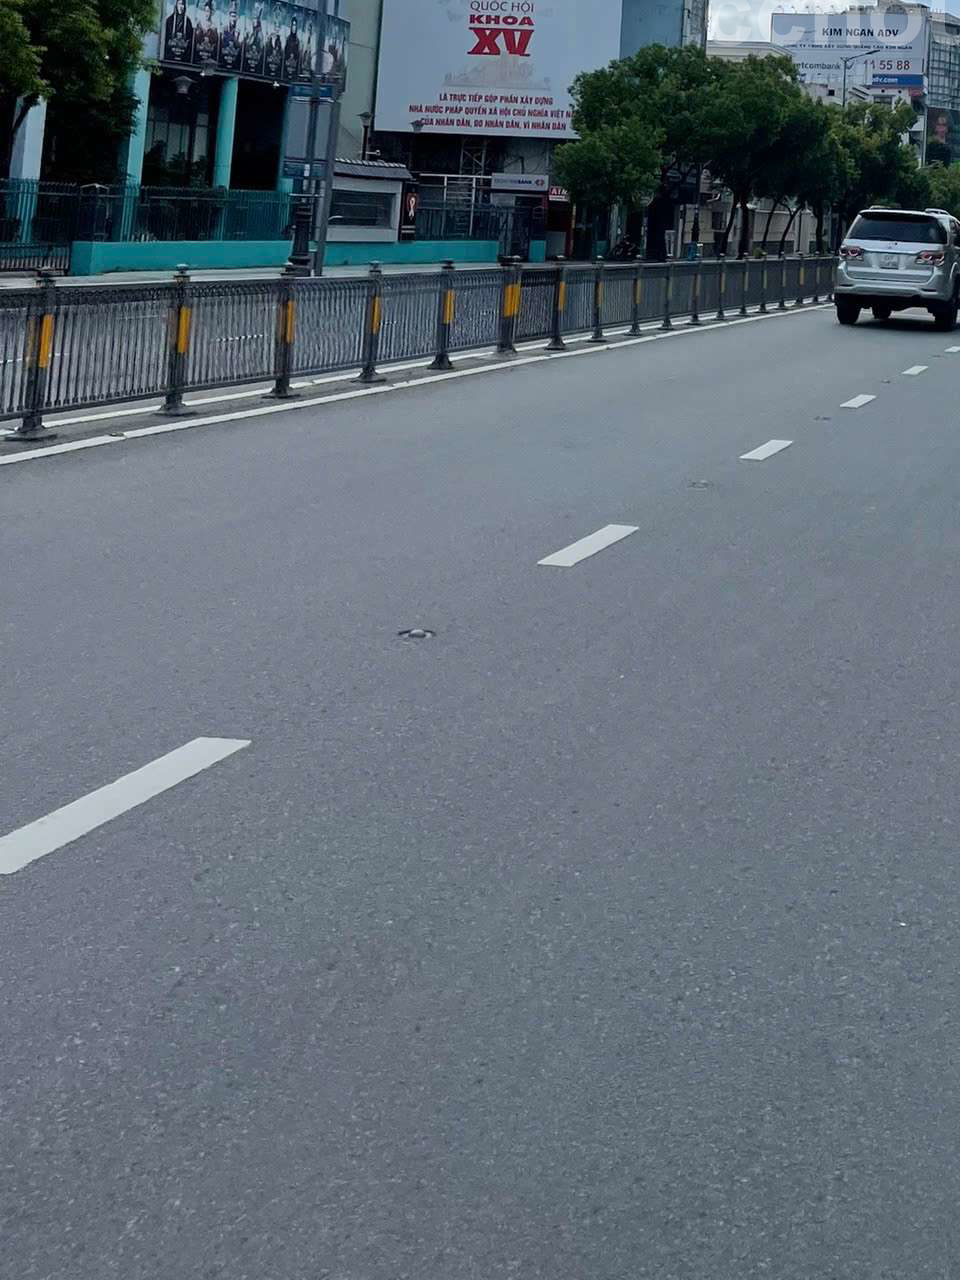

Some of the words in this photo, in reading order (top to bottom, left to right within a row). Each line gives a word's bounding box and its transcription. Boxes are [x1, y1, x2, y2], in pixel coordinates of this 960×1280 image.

[511, 0, 534, 15] HỘI
[469, 12, 534, 26] KHÓA
[822, 27, 842, 37] KIM
[877, 28, 899, 38] ADV
[467, 27, 534, 57] XV
[795, 61, 841, 71] etcombank
[879, 59, 893, 71] 55
[896, 59, 910, 71] 88
